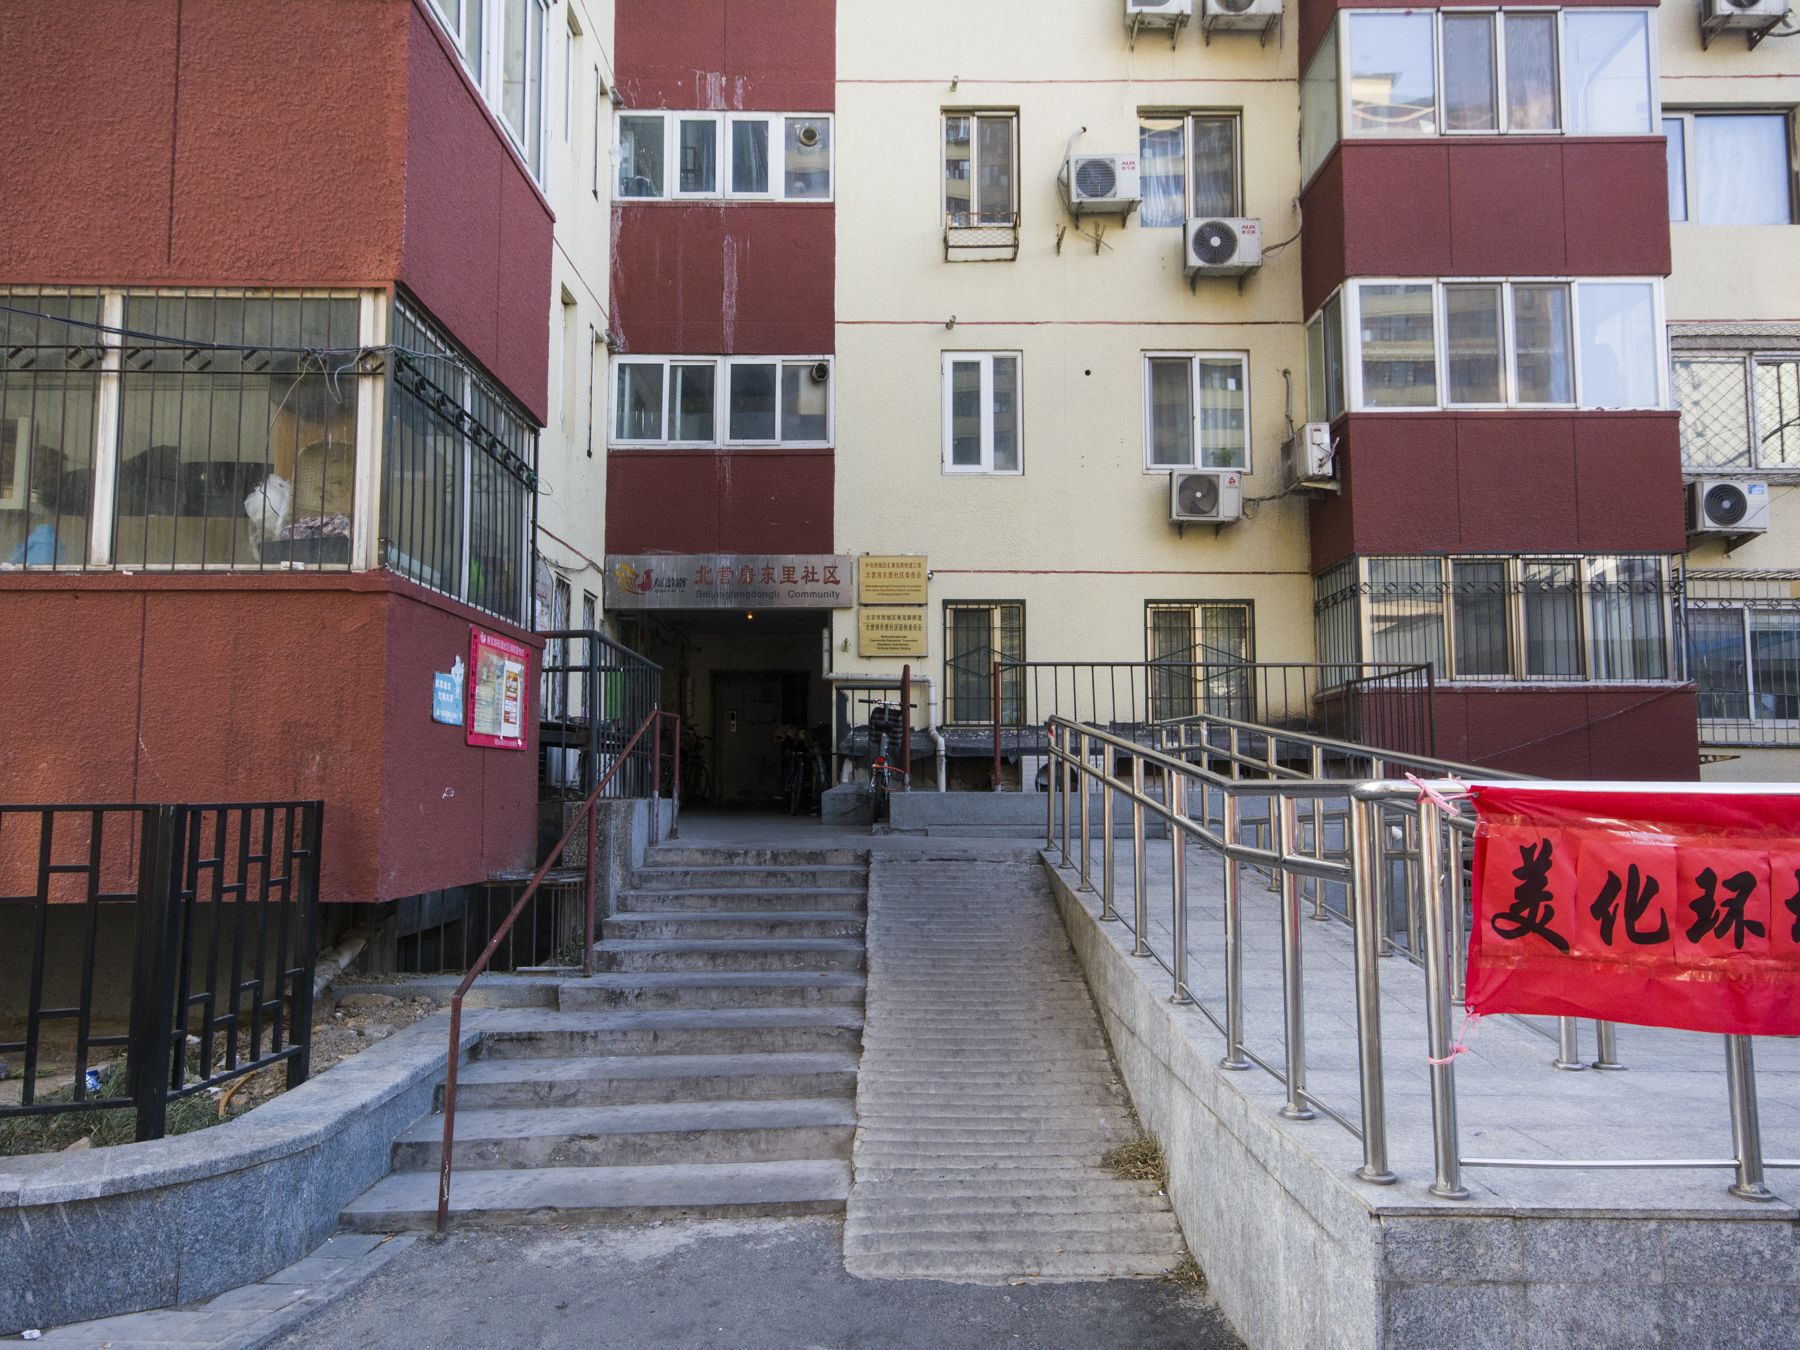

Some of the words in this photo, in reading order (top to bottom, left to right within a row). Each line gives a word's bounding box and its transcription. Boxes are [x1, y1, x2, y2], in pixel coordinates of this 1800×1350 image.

[694, 563, 841, 586] 北营房东里社区
[696, 590, 780, 600] Beiyingfangdongli
[787, 590, 841, 600] Community
[1490, 837, 1800, 955] 美化环
